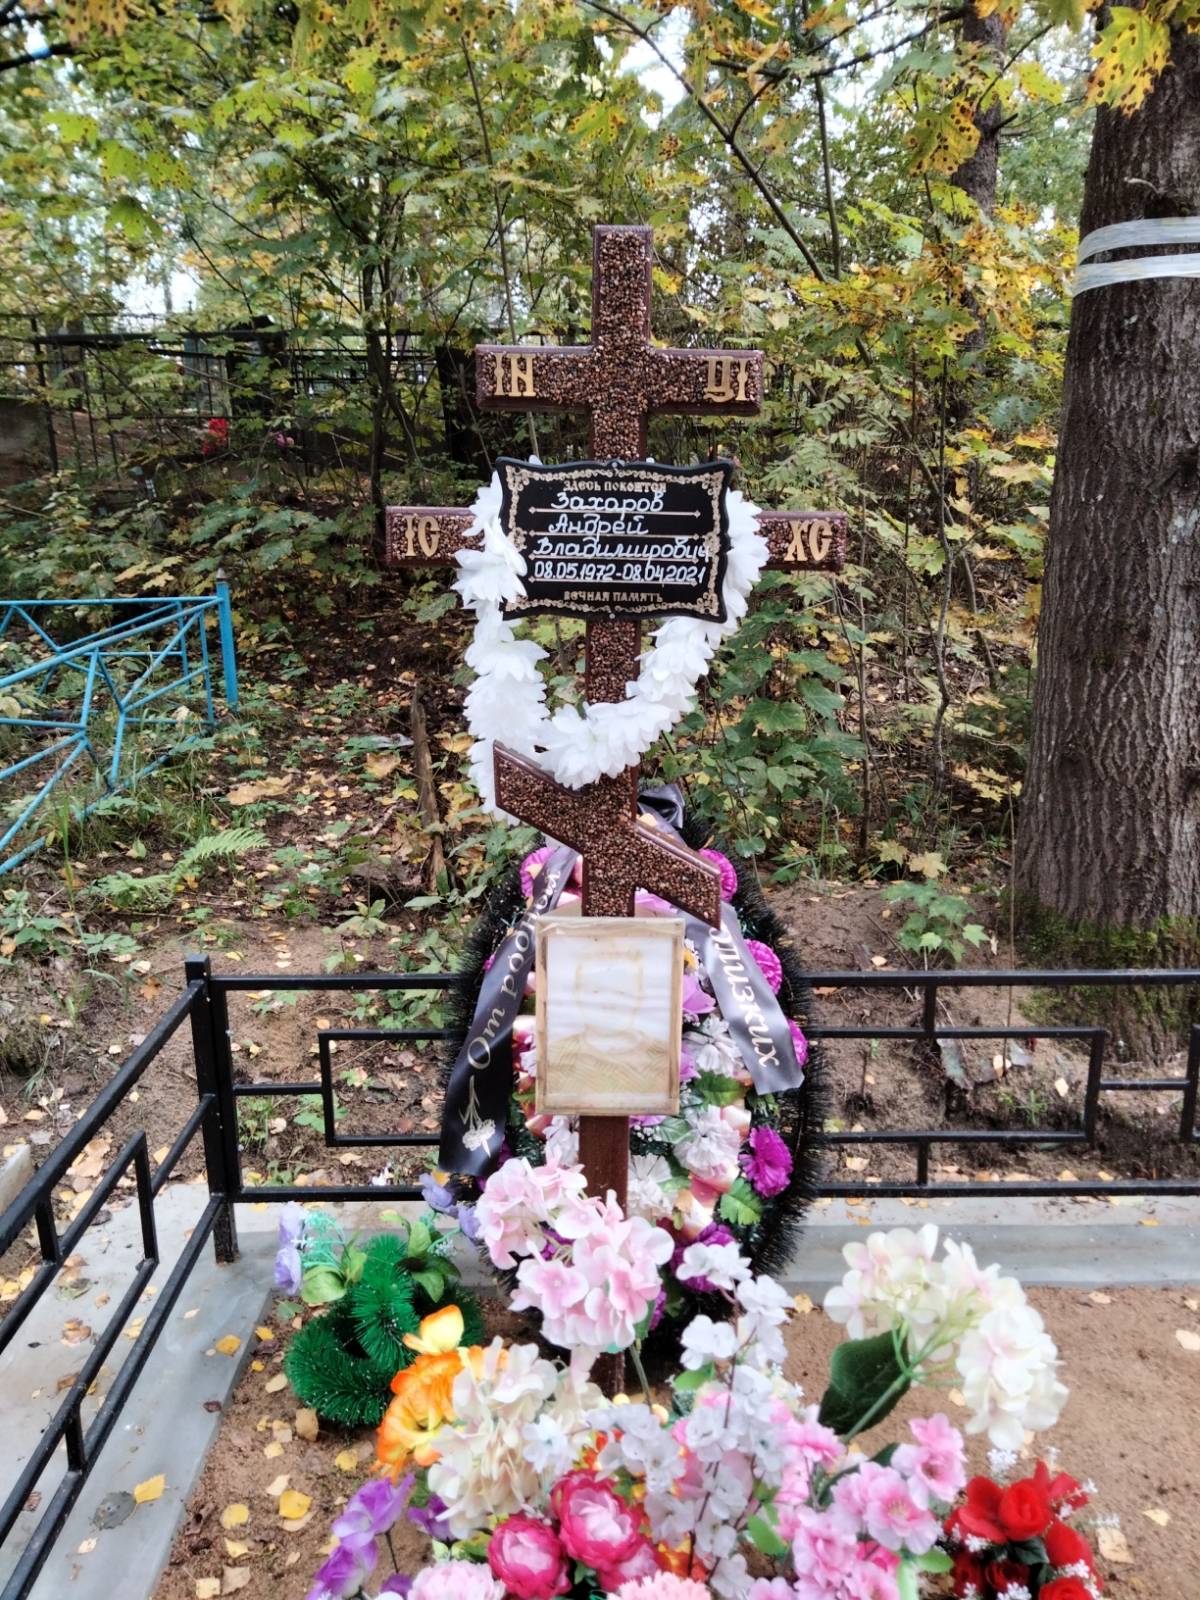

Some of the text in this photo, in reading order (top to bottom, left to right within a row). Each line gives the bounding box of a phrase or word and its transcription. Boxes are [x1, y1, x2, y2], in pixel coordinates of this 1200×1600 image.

[551, 491, 664, 520] Захаров
[548, 513, 649, 541] Андрей
[532, 536, 710, 567] Владимирович
[563, 591, 663, 603] ВЕЧНАЯ ПАМЯТЬ
[467, 1008, 505, 1070] От
